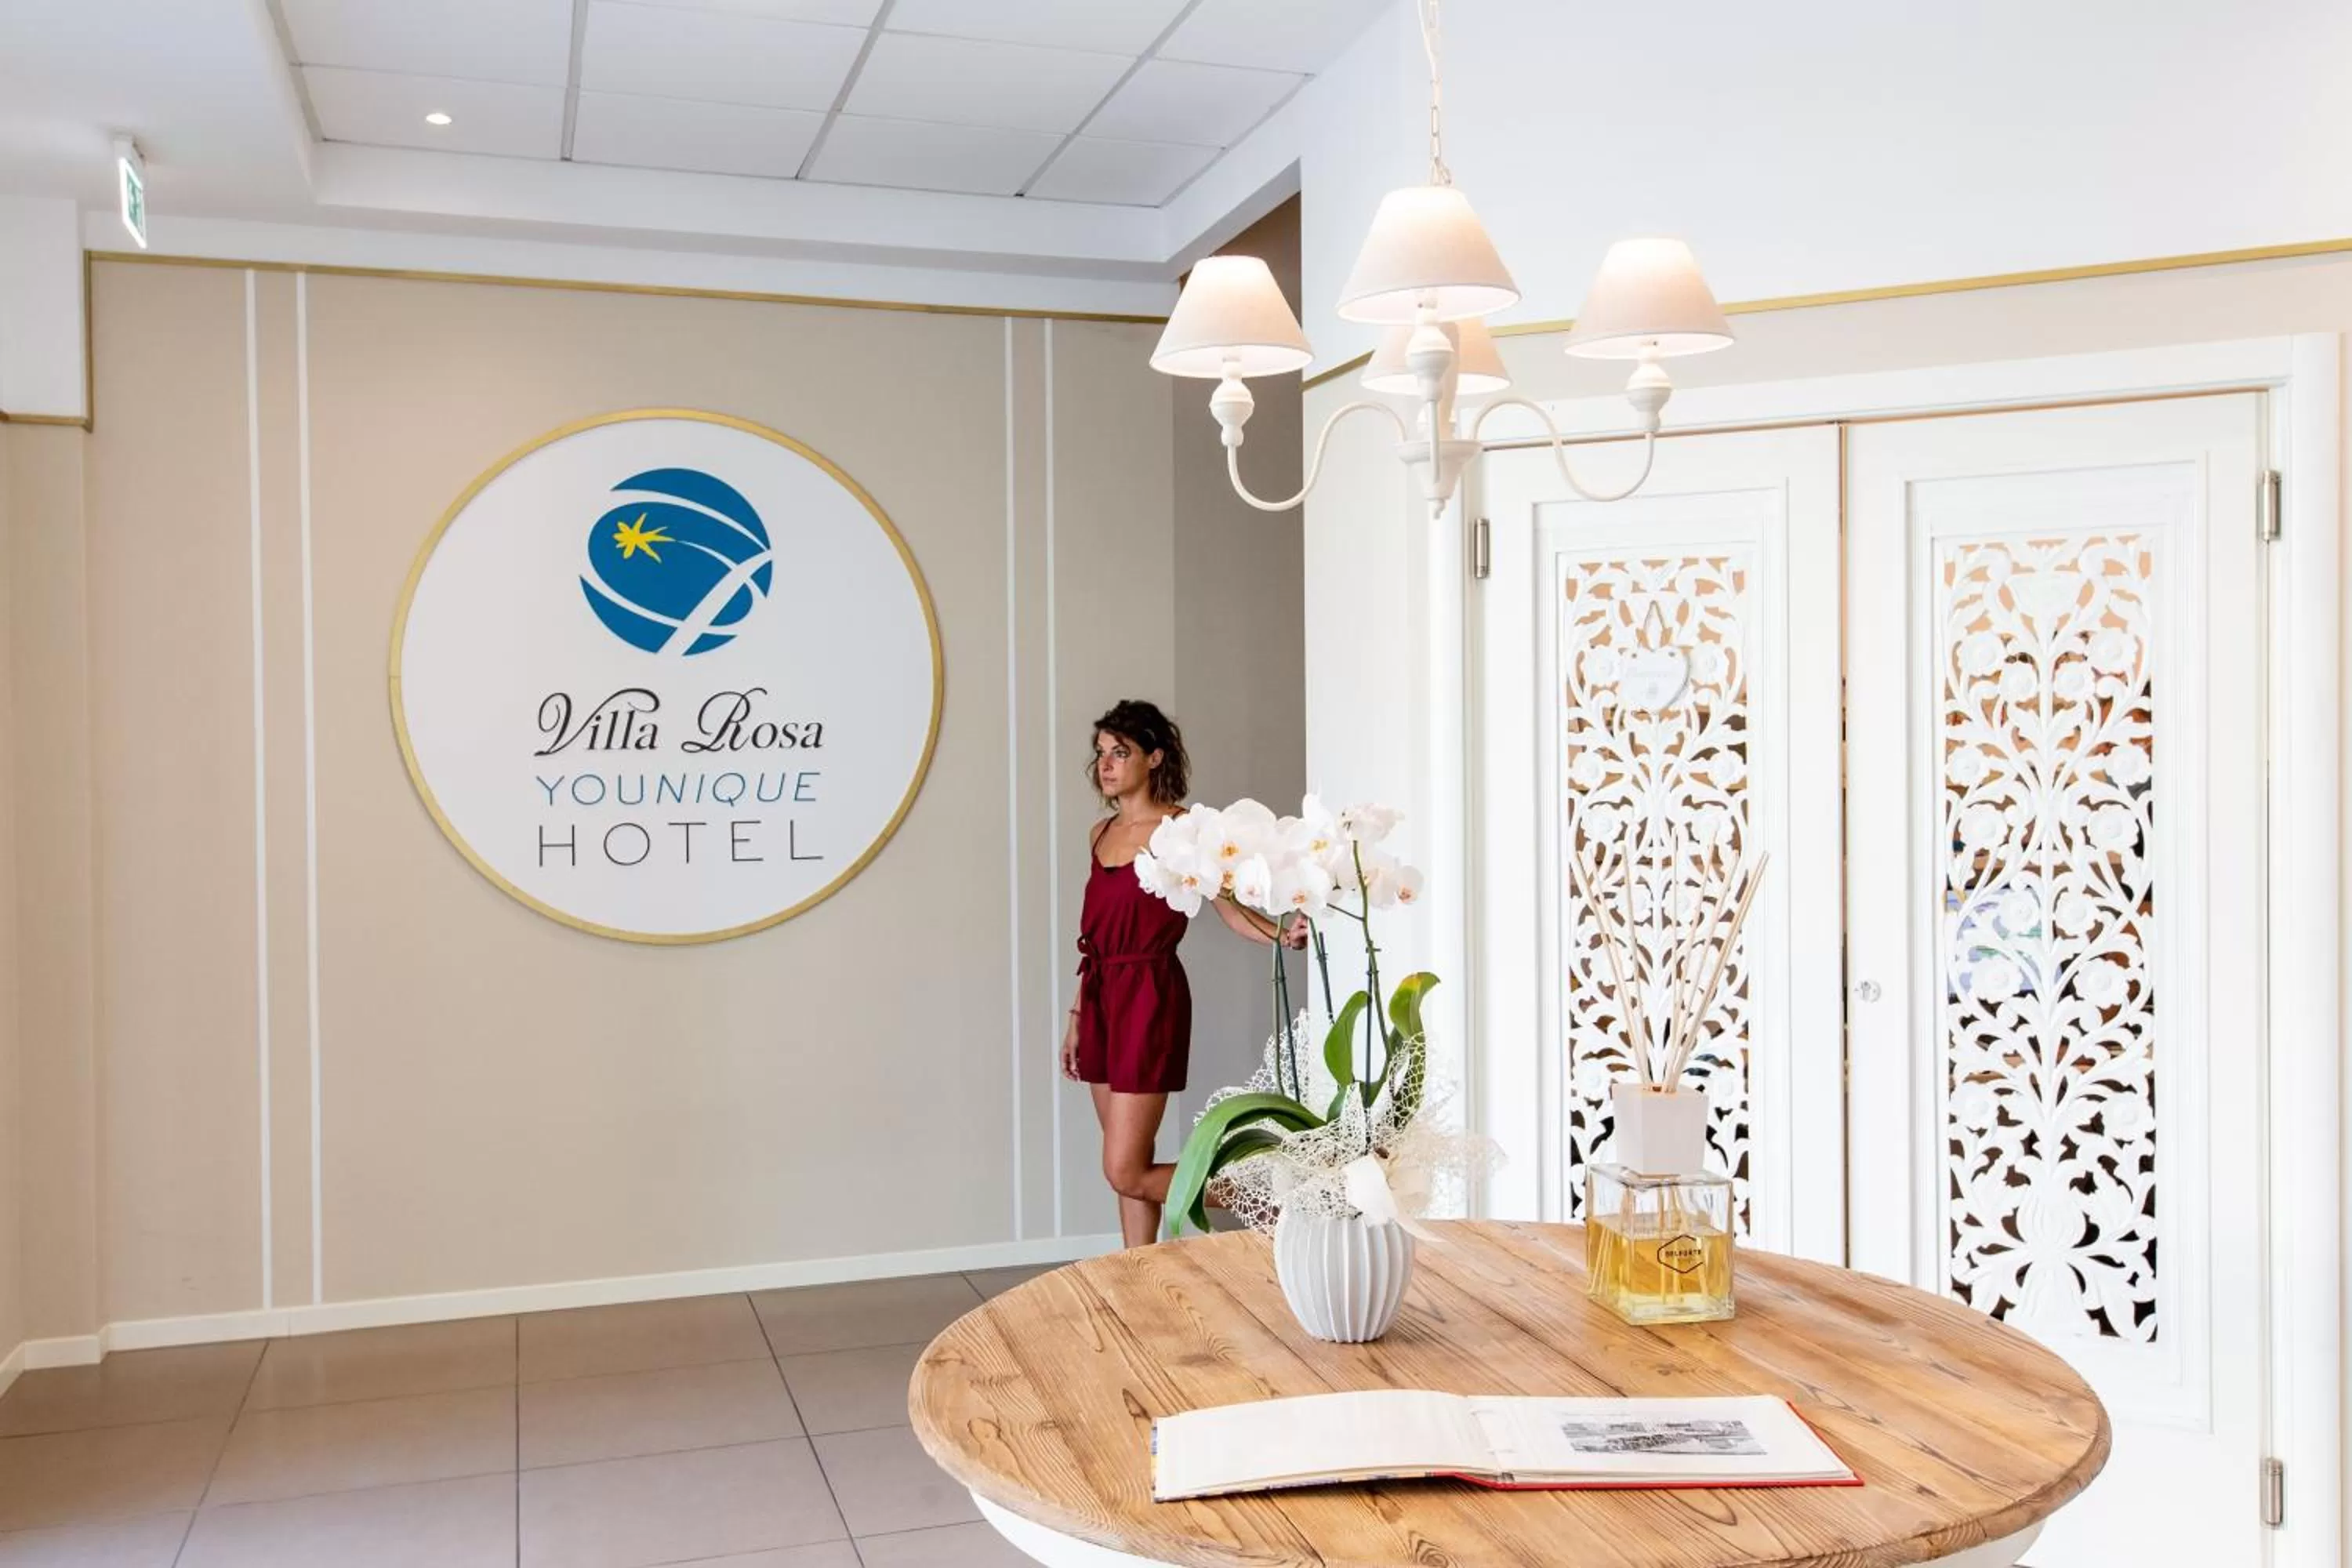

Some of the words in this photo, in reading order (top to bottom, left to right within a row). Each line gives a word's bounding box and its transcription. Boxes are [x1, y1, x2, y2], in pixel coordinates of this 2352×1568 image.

[534, 688, 661, 757] Villa
[681, 687, 823, 753] Rosa
[536, 772, 821, 807] YOUNIQUE
[539, 819, 824, 867] HOTEL
